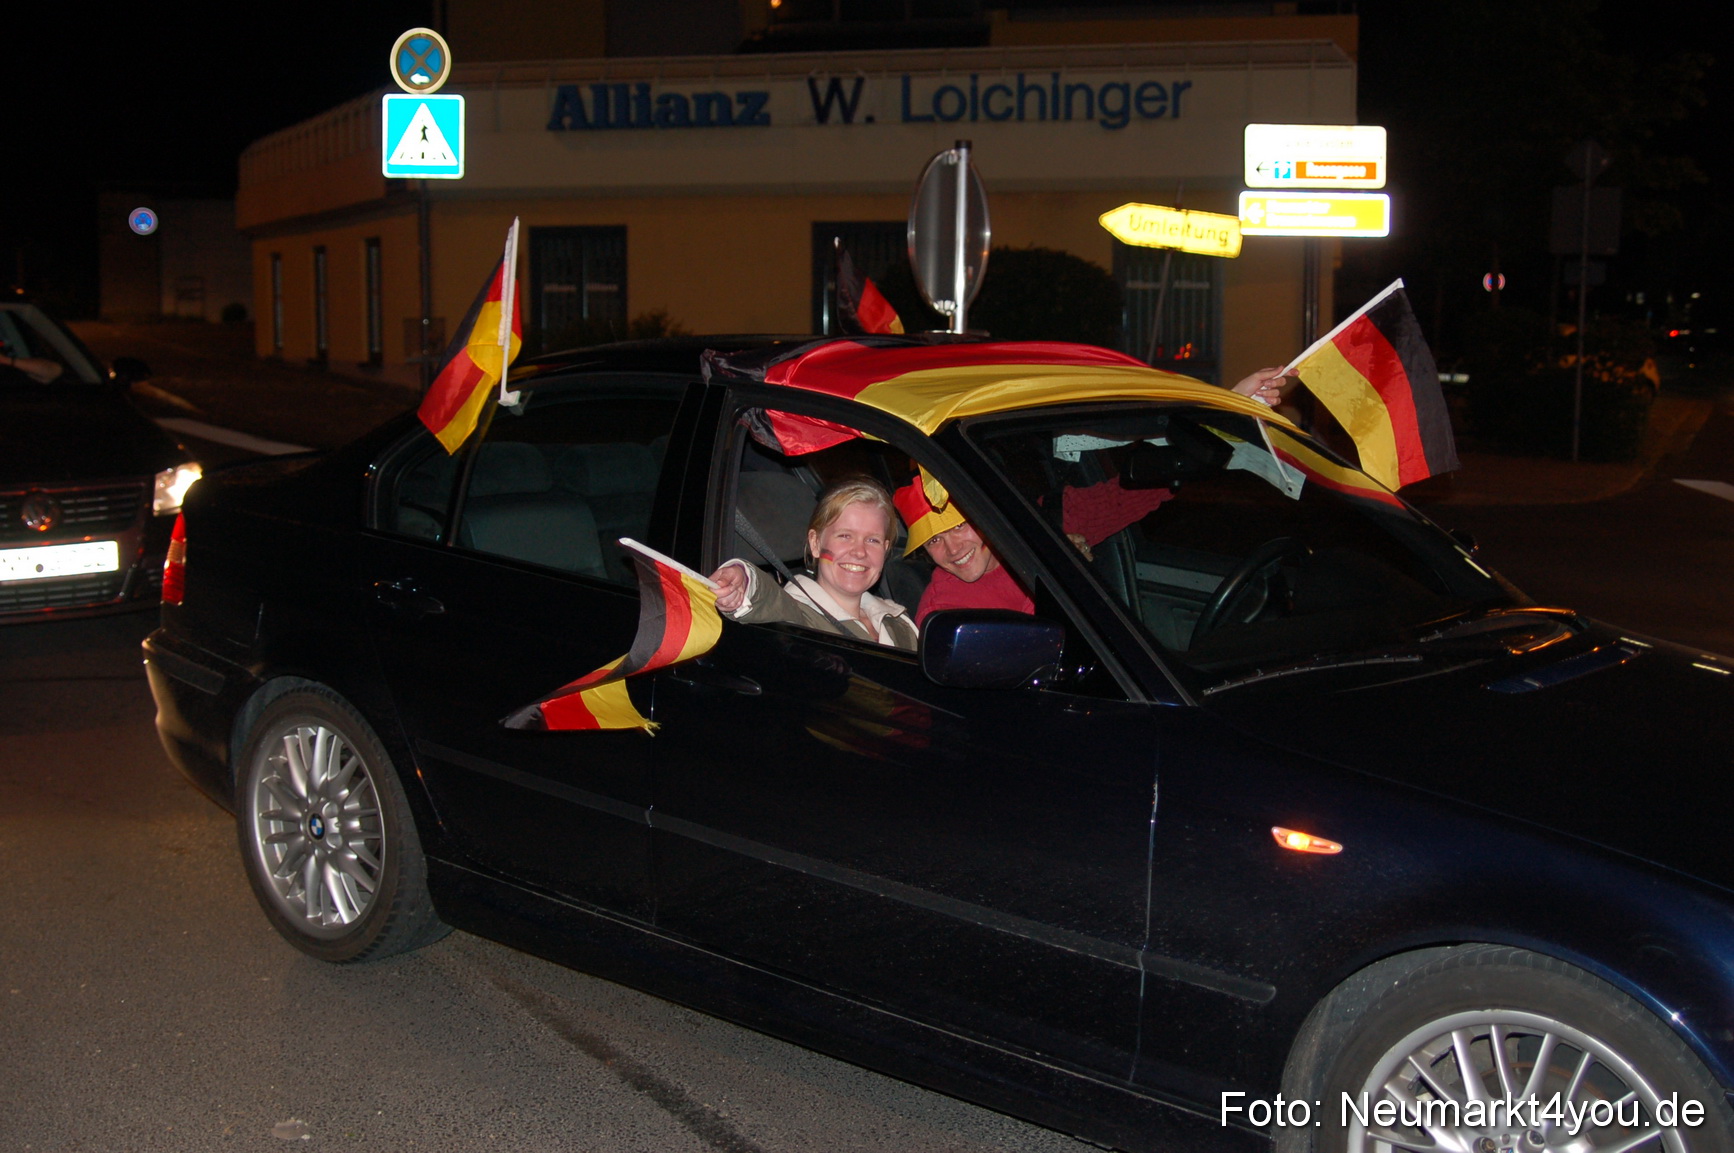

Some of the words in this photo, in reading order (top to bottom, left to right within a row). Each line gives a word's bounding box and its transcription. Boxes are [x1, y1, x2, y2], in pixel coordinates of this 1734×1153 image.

[547, 82, 770, 130] Allianz
[807, 76, 875, 124] W.
[901, 72, 1192, 130] Loichinger
[1129, 213, 1229, 247] Umleitung
